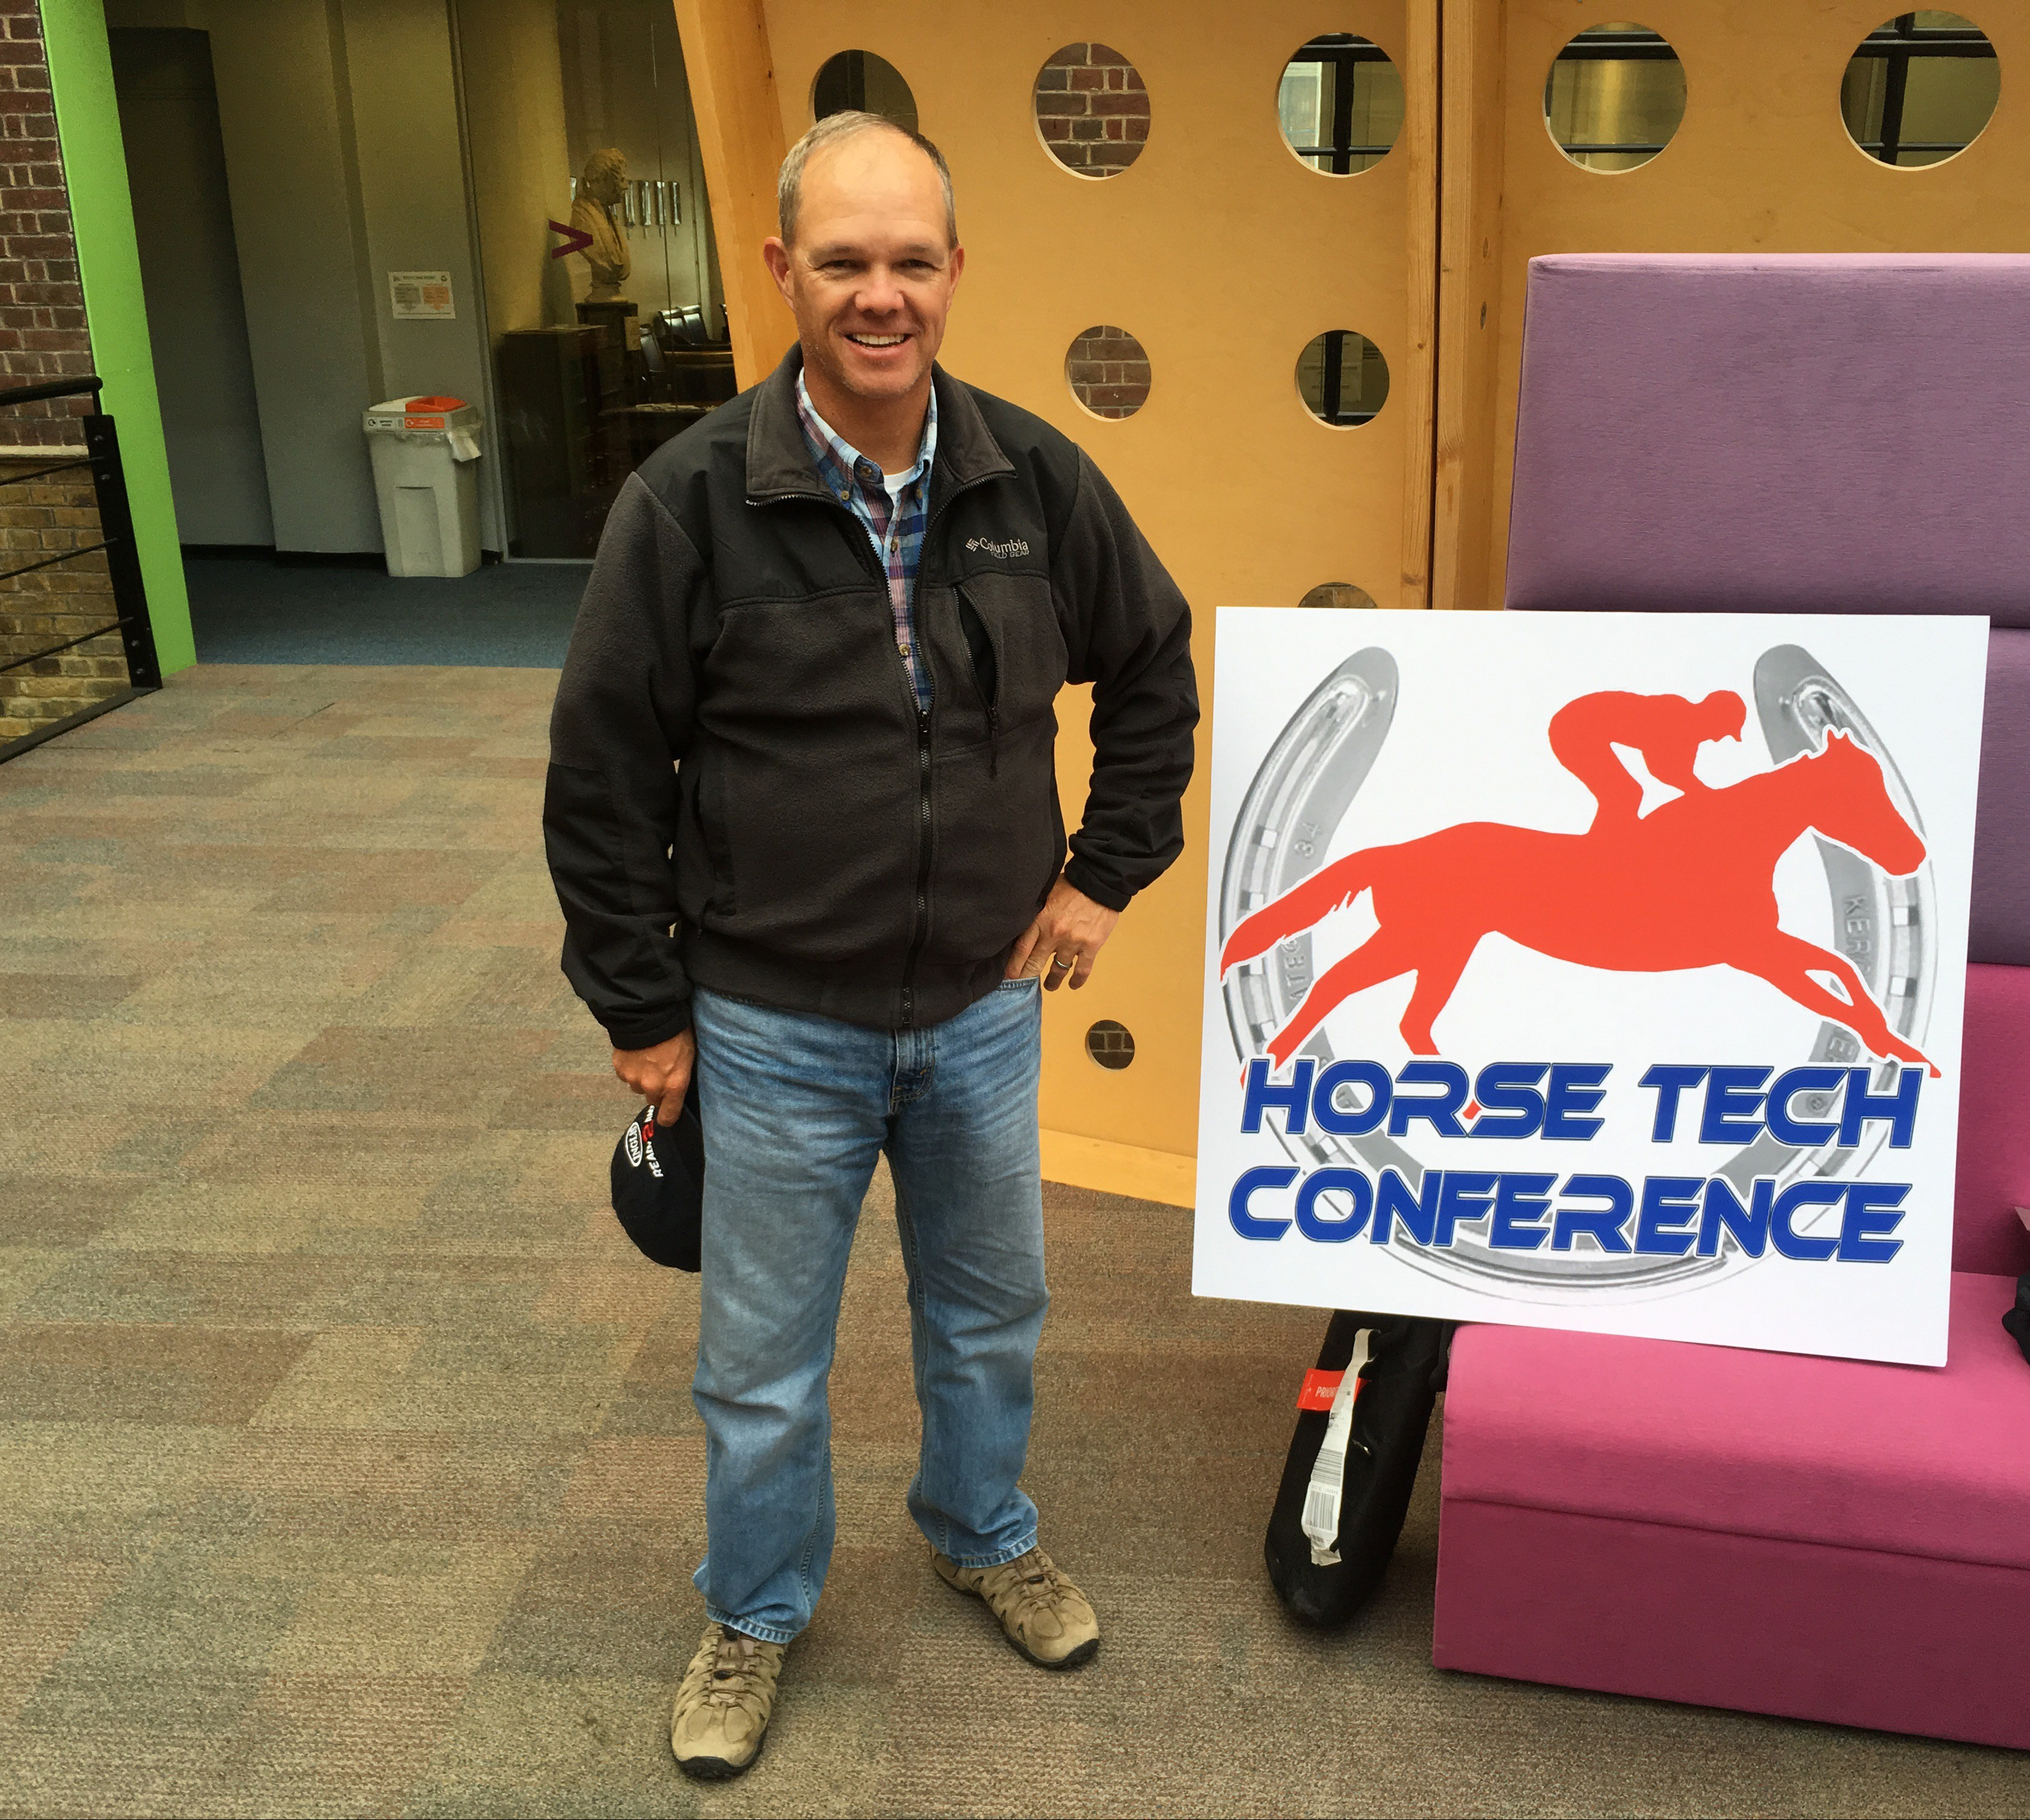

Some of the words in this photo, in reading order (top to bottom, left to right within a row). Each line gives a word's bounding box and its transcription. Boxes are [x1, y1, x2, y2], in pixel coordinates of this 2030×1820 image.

[980, 537, 1029, 554] Columbia
[1241, 1059, 1613, 1141] HORSE
[1638, 1064, 1924, 1150] TECH
[1228, 1165, 1913, 1264] CONFERENCE
[1315, 1386, 1339, 1398] PRIOR
